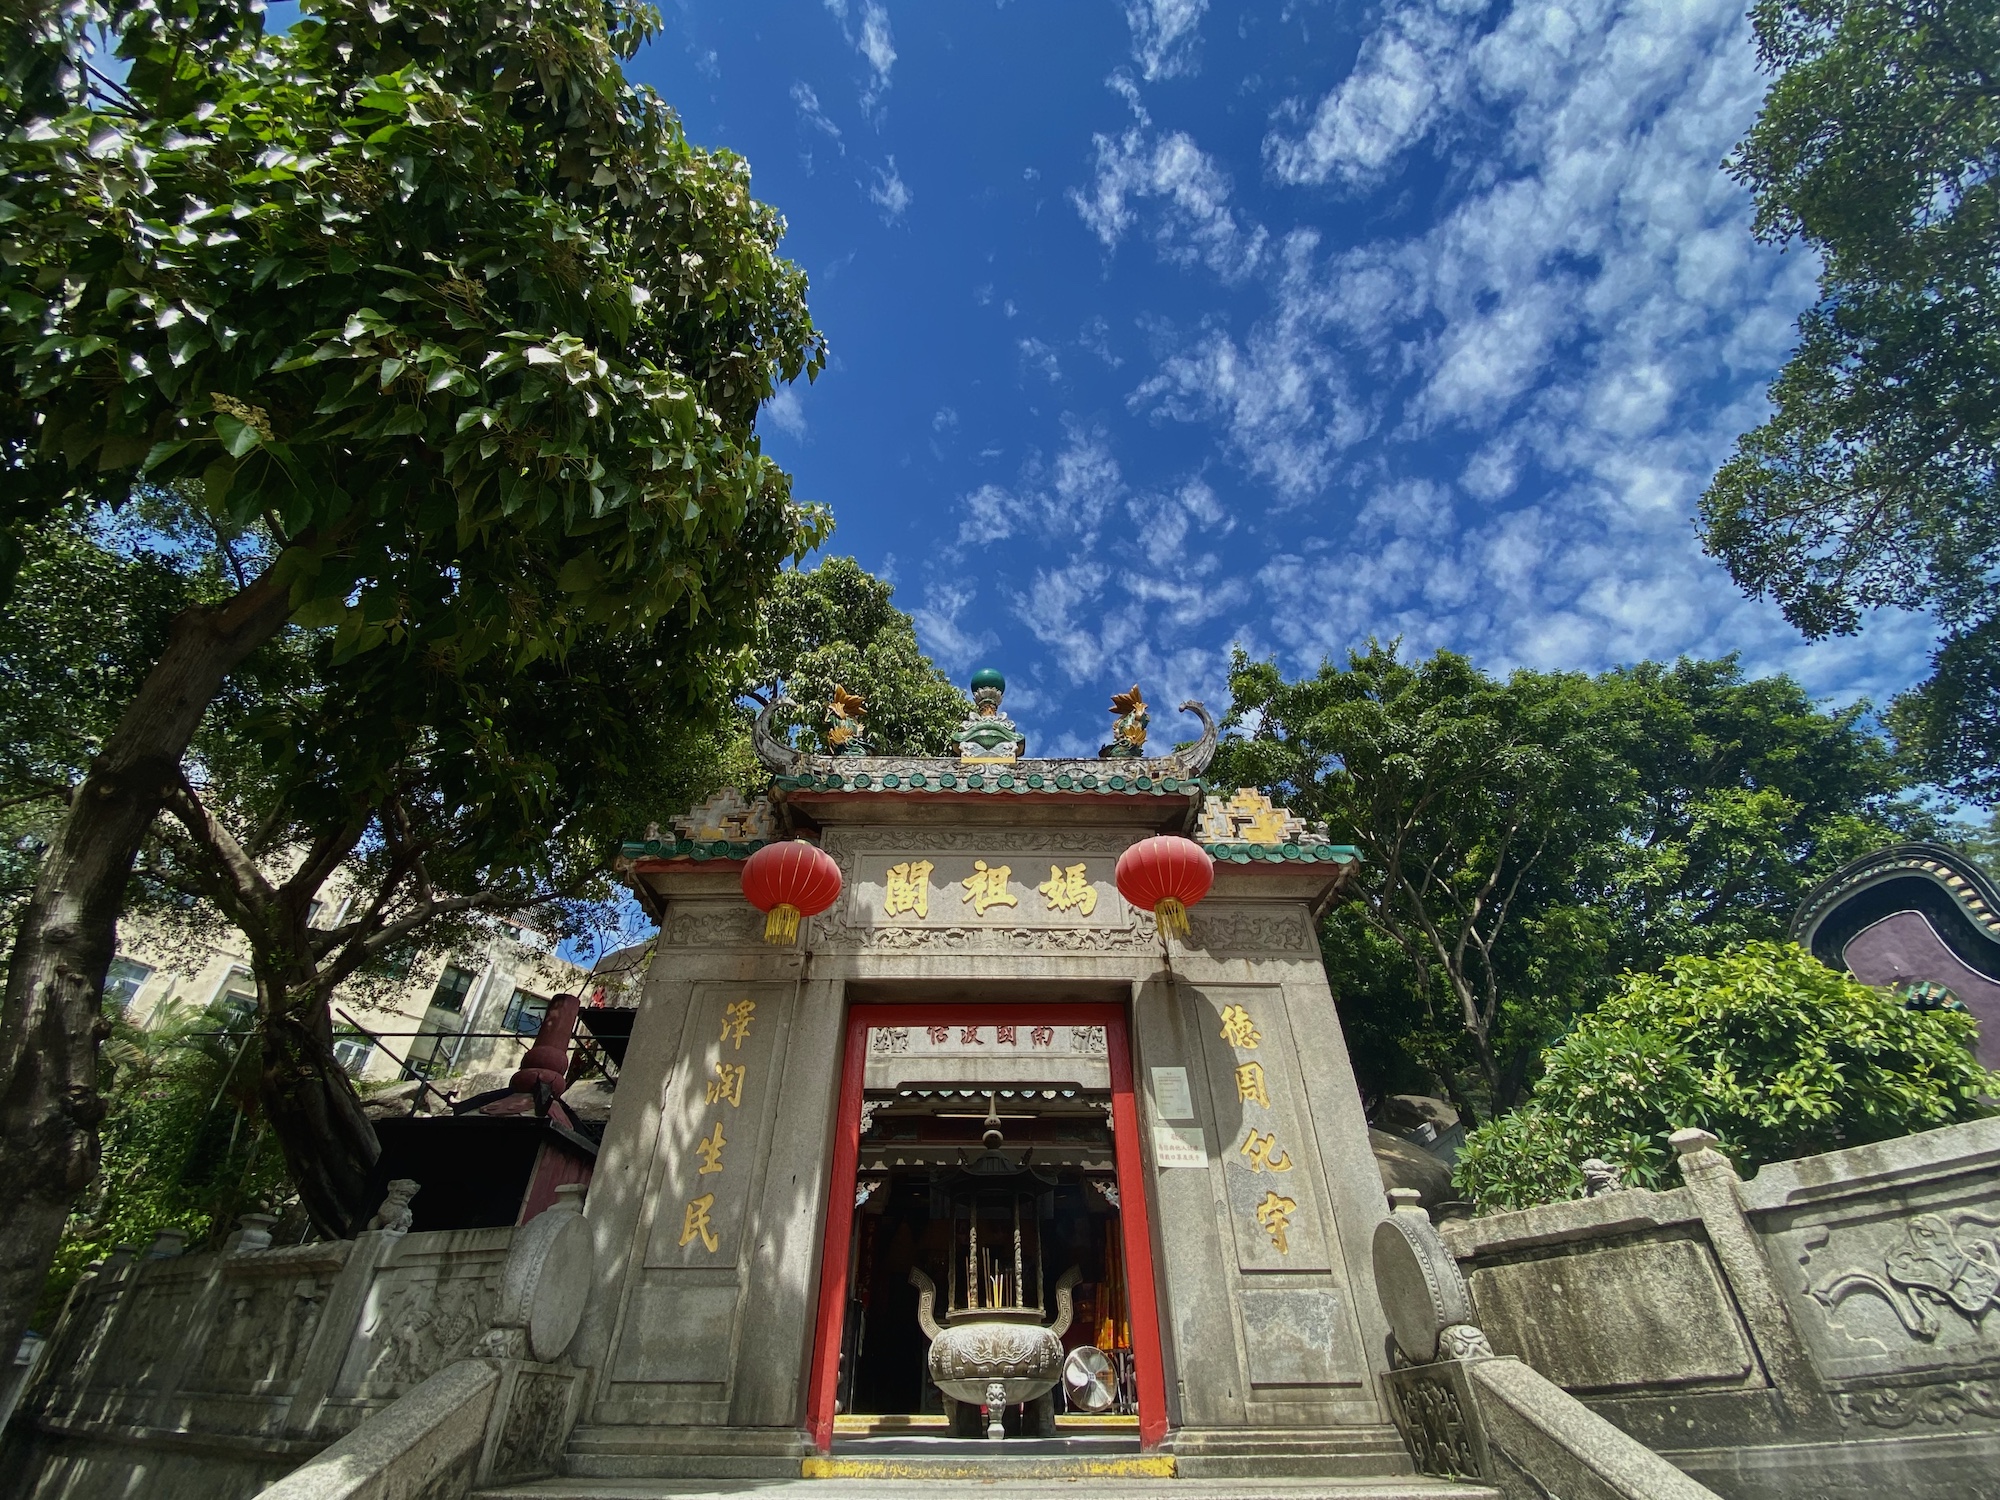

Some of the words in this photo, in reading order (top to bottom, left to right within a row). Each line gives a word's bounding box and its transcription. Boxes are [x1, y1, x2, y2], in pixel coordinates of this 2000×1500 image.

[678, 1000, 756, 1253] 澤潤生民
[1220, 1004, 1297, 1255] 德周化宇
